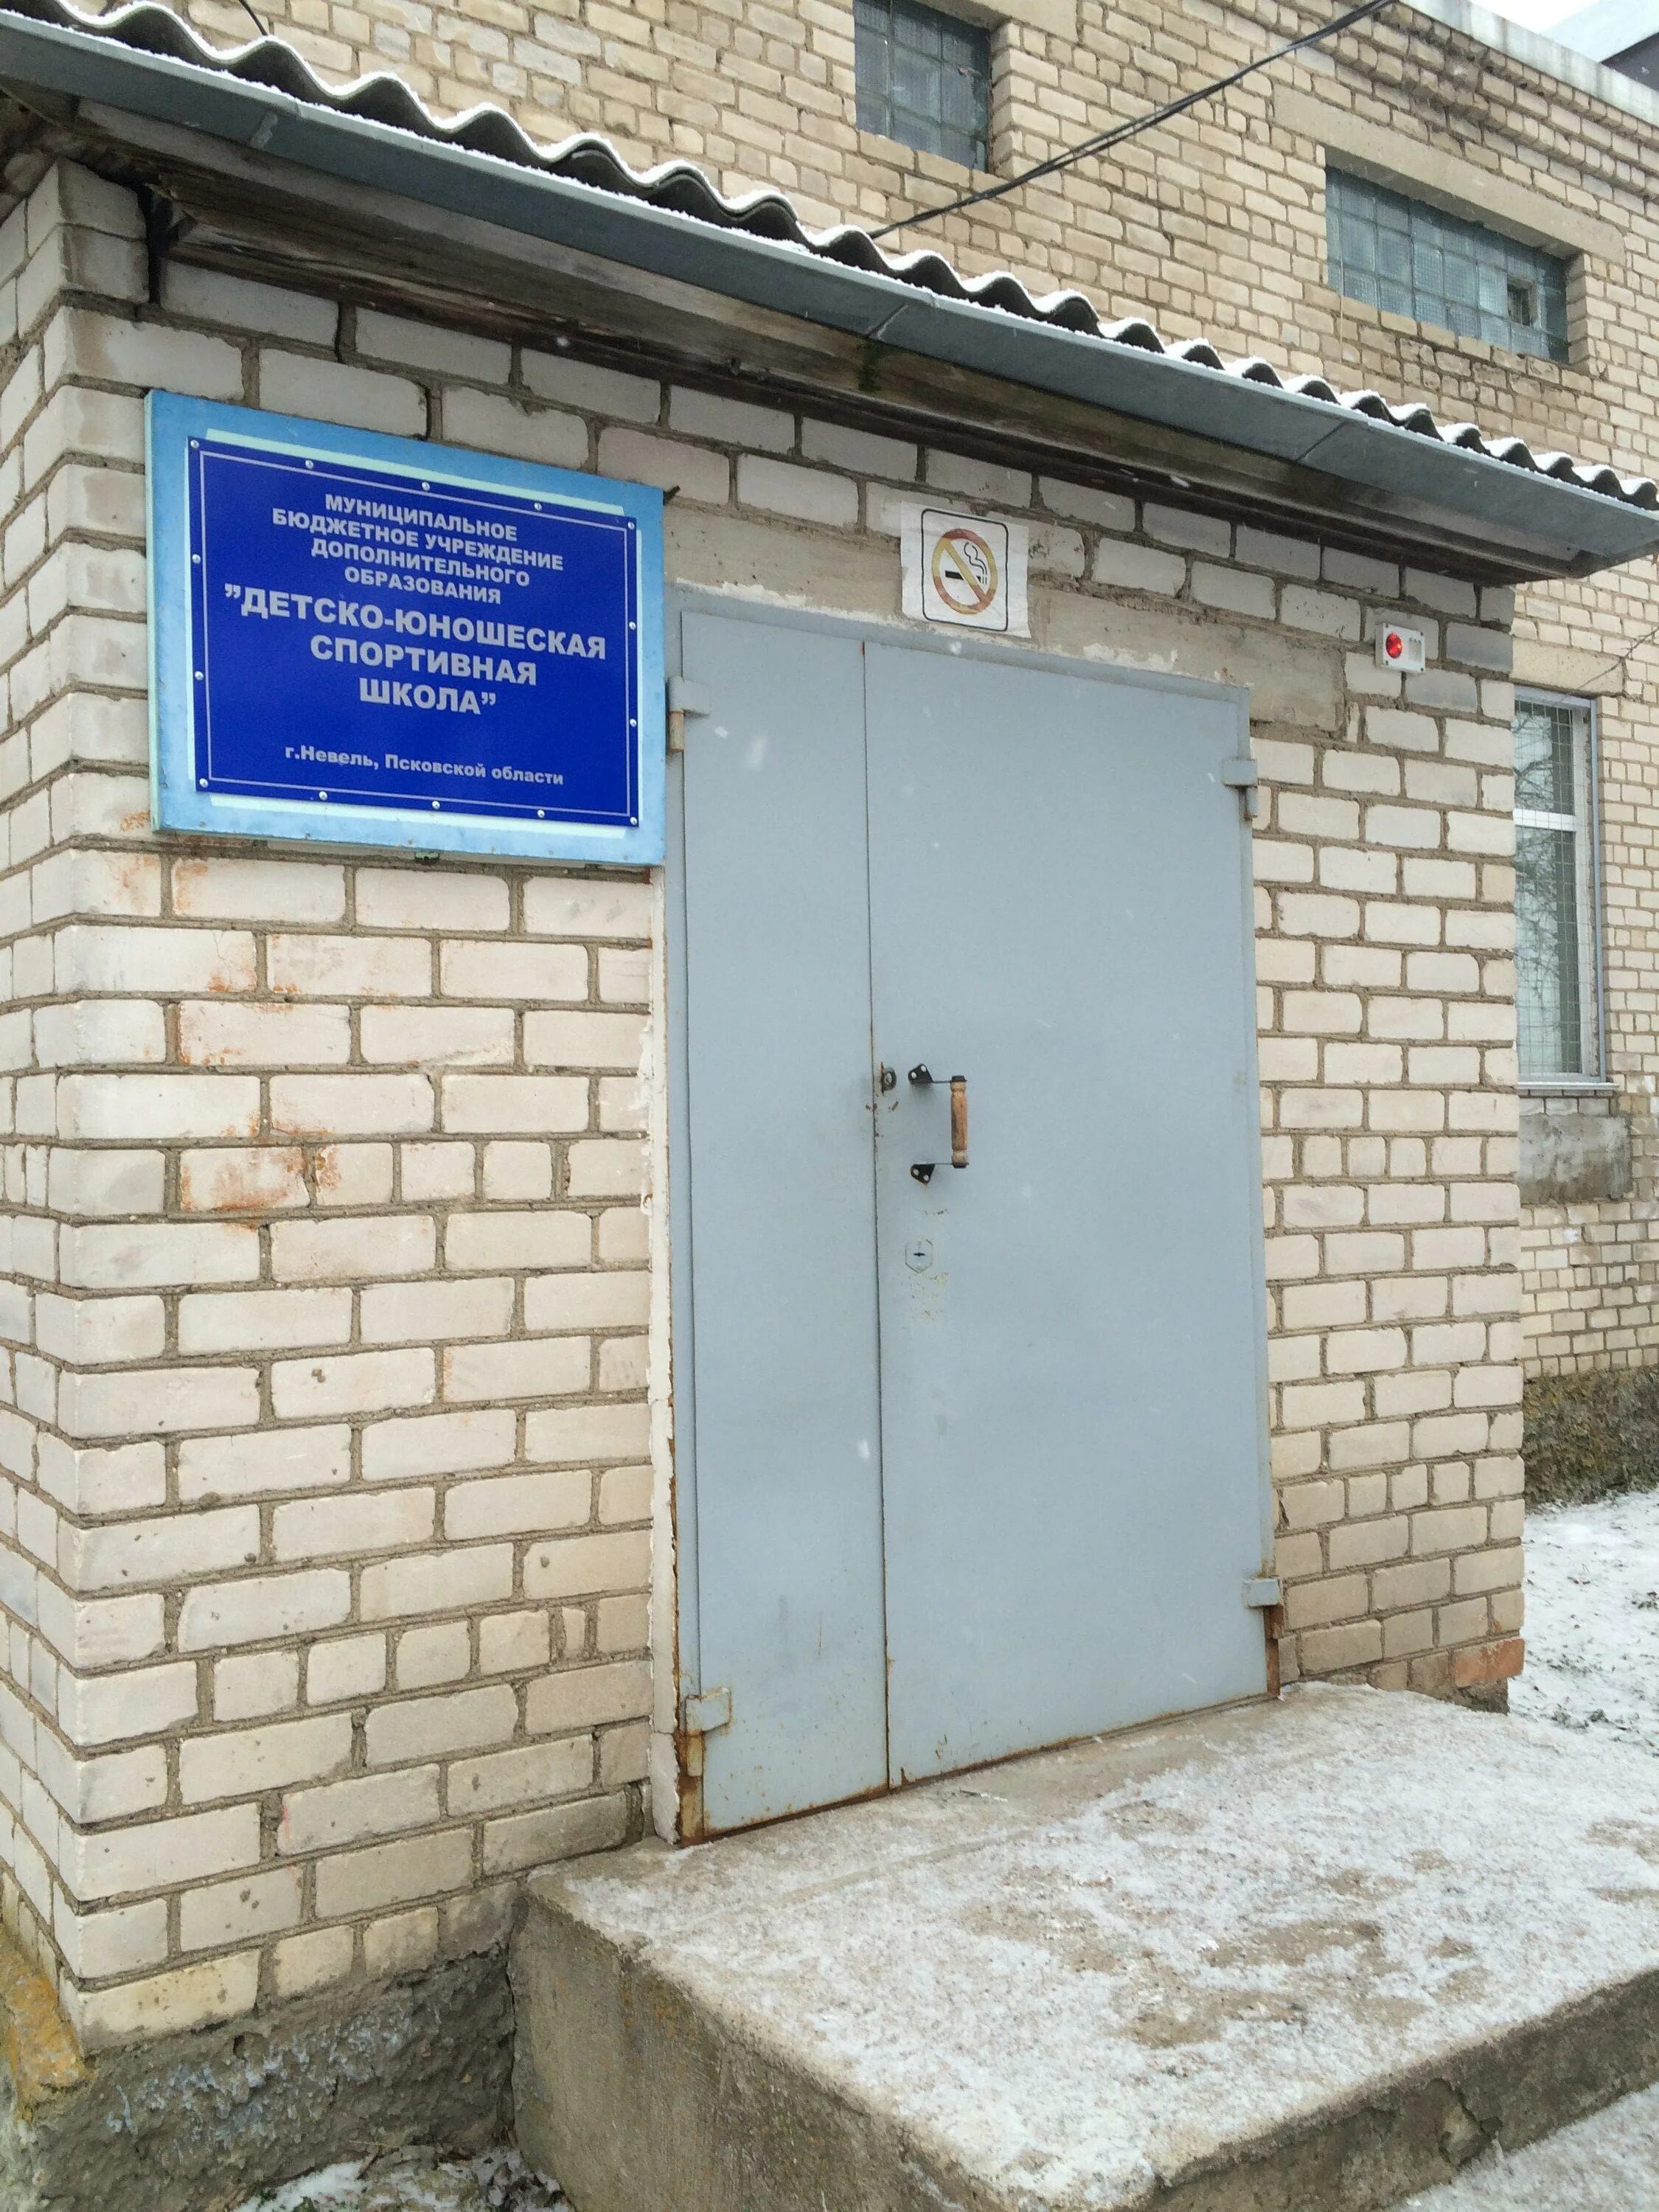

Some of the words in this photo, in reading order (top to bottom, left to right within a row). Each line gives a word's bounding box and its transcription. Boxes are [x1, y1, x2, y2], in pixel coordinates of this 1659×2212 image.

[273, 508, 419, 548] БЮДЖЕТНОЕ
[425, 533, 563, 571] УЧРЕЖДЕНИЕ
[326, 493, 518, 541] МУНИЦИПАЛЬНОЕ
[311, 538, 530, 586] ДОПОЛНИТЕЛЬНОГО
[344, 567, 501, 604] ОБРАЗОВАНИЯ
[310, 636, 537, 685] СПОРТИВНАЯ
[285, 745, 379, 769] г.Невель,
[386, 754, 486, 778] Псковской
[491, 765, 563, 785] области
